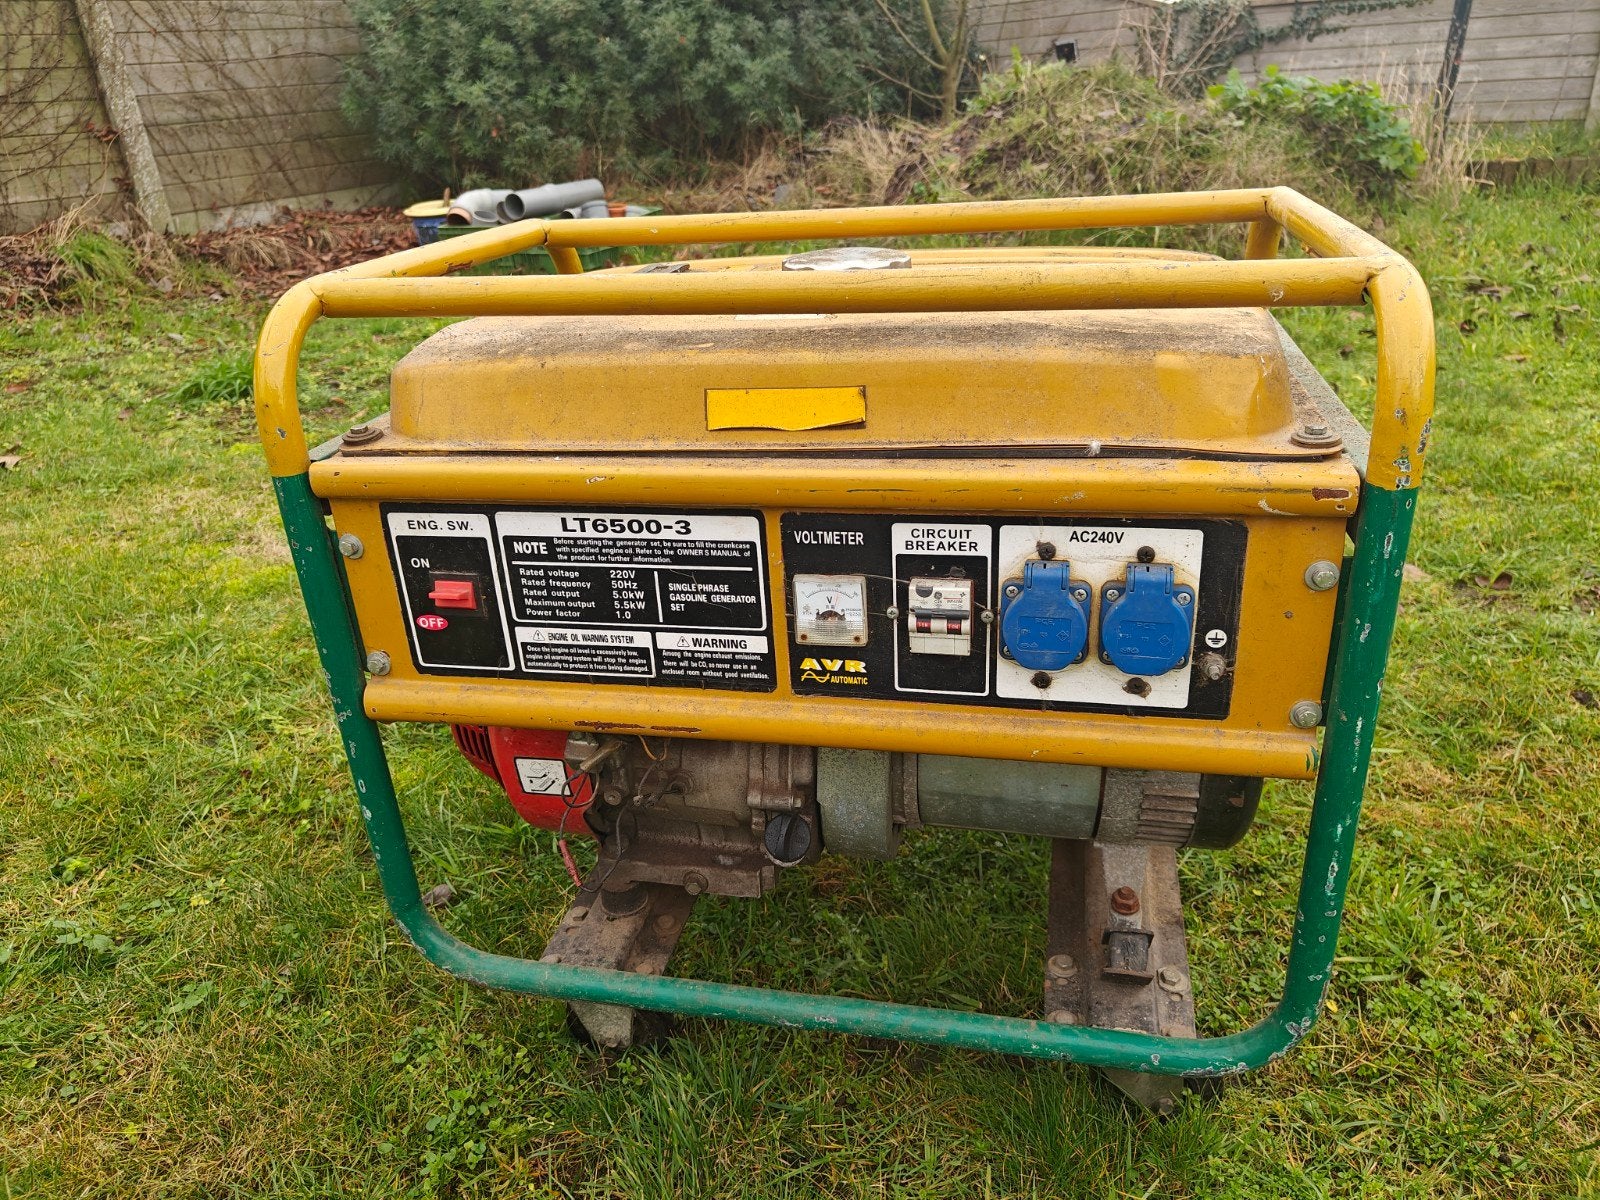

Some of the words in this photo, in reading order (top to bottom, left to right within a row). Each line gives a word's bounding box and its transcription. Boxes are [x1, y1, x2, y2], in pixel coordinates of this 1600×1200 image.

[407, 520, 443, 531] ENG.
[447, 520, 474, 531] SW.
[560, 517, 692, 535] LT6500-3
[794, 530, 864, 545] VOLTMETER
[911, 528, 972, 540] CIRCUIT
[1069, 531, 1125, 544] AC240V
[513, 541, 549, 555] NOTE
[577, 539, 601, 547] starting
[616, 540, 647, 548] generator
[905, 540, 978, 552] BREAKER
[571, 546, 599, 554] specified
[602, 547, 623, 555] engine
[625, 547, 634, 555] oil.
[410, 557, 430, 569] ON
[570, 554, 596, 562] product
[520, 567, 544, 576] Rated
[548, 568, 580, 578] voltage
[609, 570, 636, 579] 220V
[521, 578, 546, 586] Rated
[549, 579, 591, 589] frequency
[611, 580, 638, 589] 50Hz
[668, 583, 696, 592] SINGLE
[698, 583, 729, 593] PHRASE
[523, 588, 547, 596] Rated
[551, 589, 580, 598] output
[612, 591, 645, 599] 5.0kW
[669, 593, 707, 602] GASOLINE
[711, 594, 757, 604] GENERATOR
[524, 598, 565, 607] Maximum
[567, 600, 596, 609] output
[614, 601, 646, 610] 5.5kW
[826, 596, 833, 604] V
[670, 603, 685, 612] SET
[526, 608, 552, 616] Power
[555, 609, 581, 617] factor
[616, 611, 632, 619] 1.0
[420, 617, 444, 628] OFF
[548, 632, 569, 641] ENGINE
[571, 633, 580, 642] OIL
[581, 634, 609, 644] WARNING
[610, 635, 635, 644] SYSTEM
[691, 637, 748, 650] WARNING
[596, 648, 626, 657] excessively
[662, 649, 681, 658] Among
[683, 650, 692, 658] the
[694, 651, 711, 659] engine
[712, 651, 733, 660] exhaust
[527, 661, 562, 669] automatically
[608, 664, 623, 672] being
[573, 656, 592, 664] system
[629, 658, 647, 666] engine
[743, 662, 748, 670] in
[800, 657, 867, 673] AVR
[702, 669, 723, 677] without
[725, 671, 739, 679] good
[830, 676, 868, 685] AUTOMATIC
